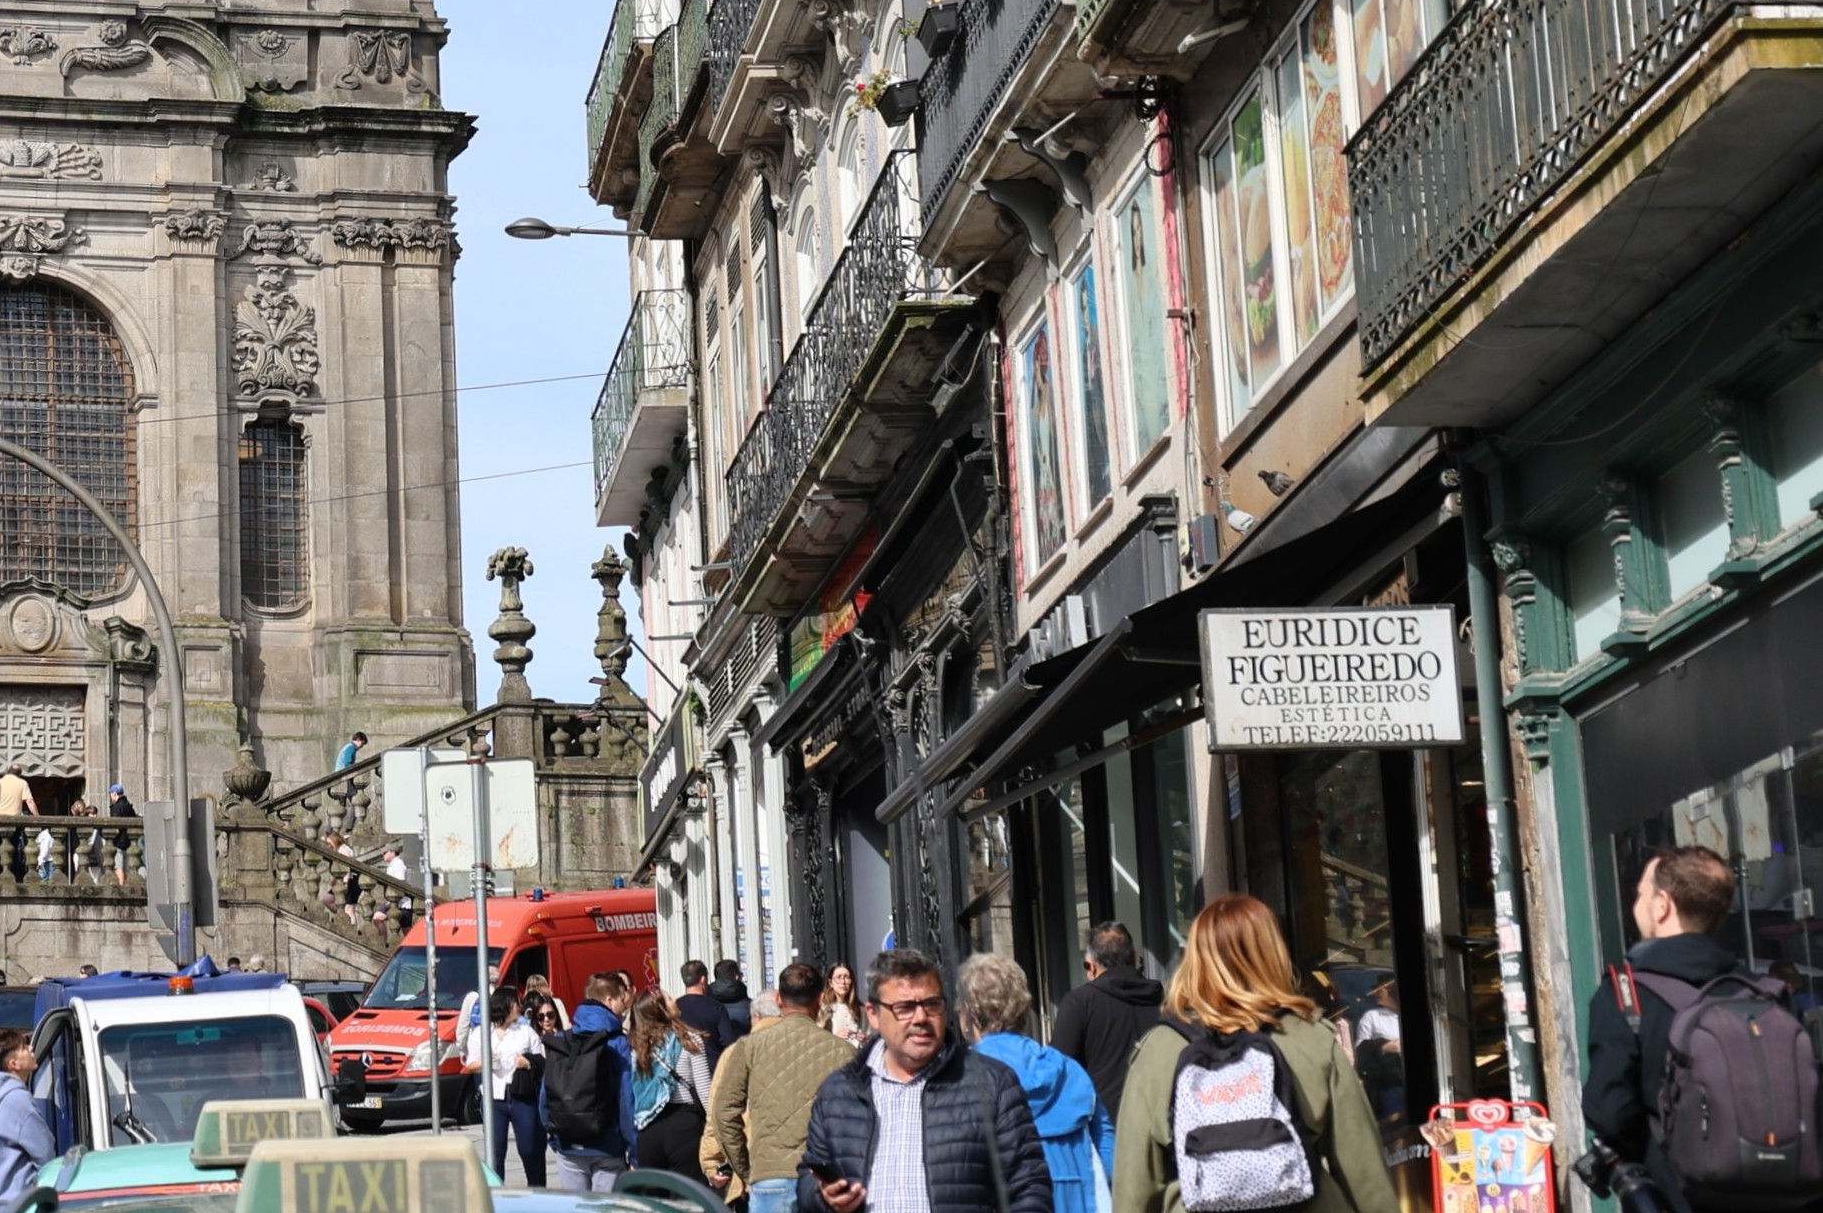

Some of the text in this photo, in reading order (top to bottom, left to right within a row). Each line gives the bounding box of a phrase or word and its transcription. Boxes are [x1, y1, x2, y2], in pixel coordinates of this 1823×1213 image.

[1242, 616, 1422, 649] EURIDICE
[1228, 651, 1442, 685] FIGUEIREDO
[1240, 683, 1431, 706] CABELEIREIROS
[1280, 704, 1392, 724] ESTÉTICA
[230, 1113, 290, 1142] TAXI
[298, 1161, 407, 1213] TAXI
